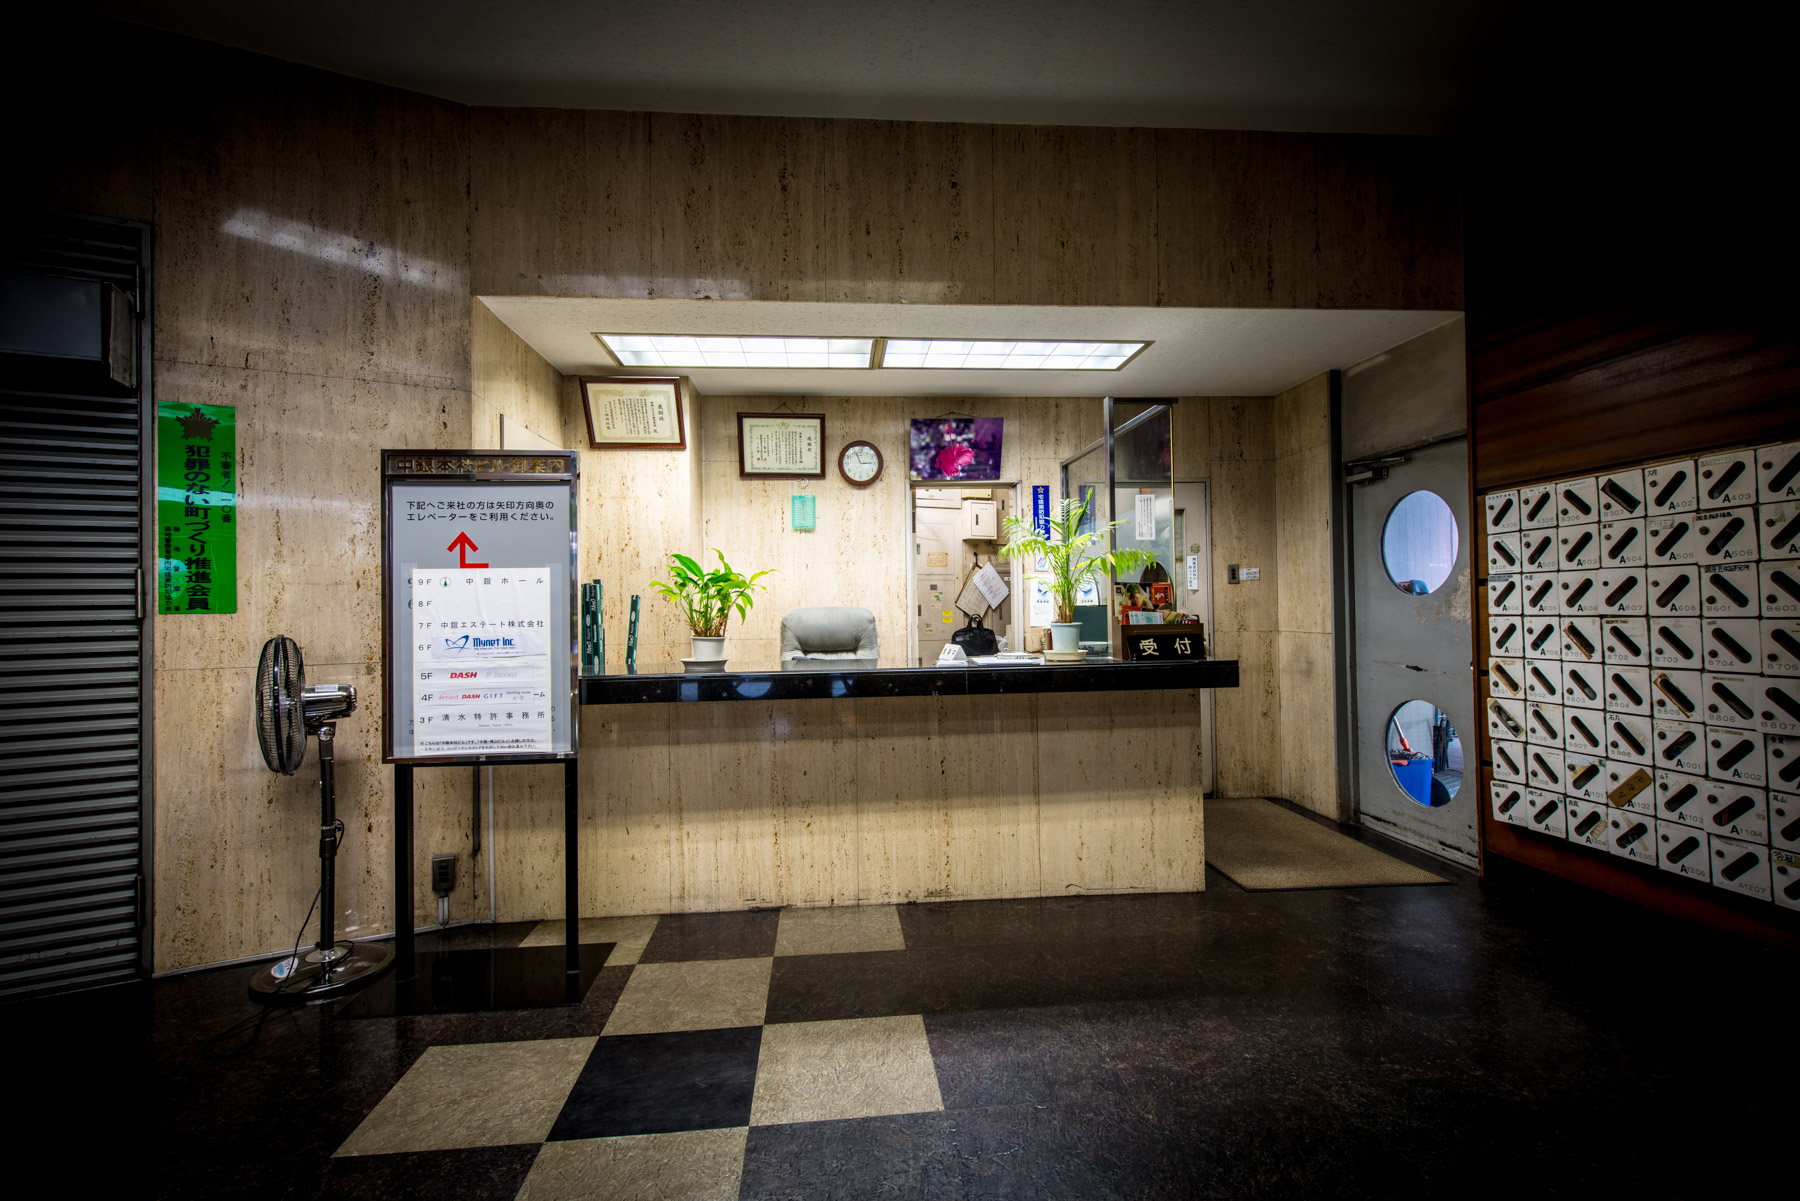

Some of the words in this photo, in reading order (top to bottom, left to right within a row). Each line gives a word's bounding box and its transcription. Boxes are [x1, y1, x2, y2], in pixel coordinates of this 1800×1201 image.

[396, 457, 565, 474] 中銀本社ビル御案内
[1722, 493, 1751, 503] A403
[406, 500, 555, 511] 下記へご来社の方は矢印方向奥の
[406, 511, 555, 522] エレベーターをご利用ください。
[184, 444, 212, 611] 犯罪のない町づくり推進会員
[465, 576, 544, 586] 中銀ホール
[1618, 603, 1643, 611] A607
[440, 620, 545, 630] 中銀エステート株式会社
[473, 637, 501, 648] Mynet
[1139, 637, 1191, 656] 受付
[420, 672, 433, 681] 5F
[449, 671, 478, 680] DASH
[421, 693, 434, 702] 4F
[441, 711, 545, 722] 清水特許事務所
[1761, 721, 1797, 730] B807
